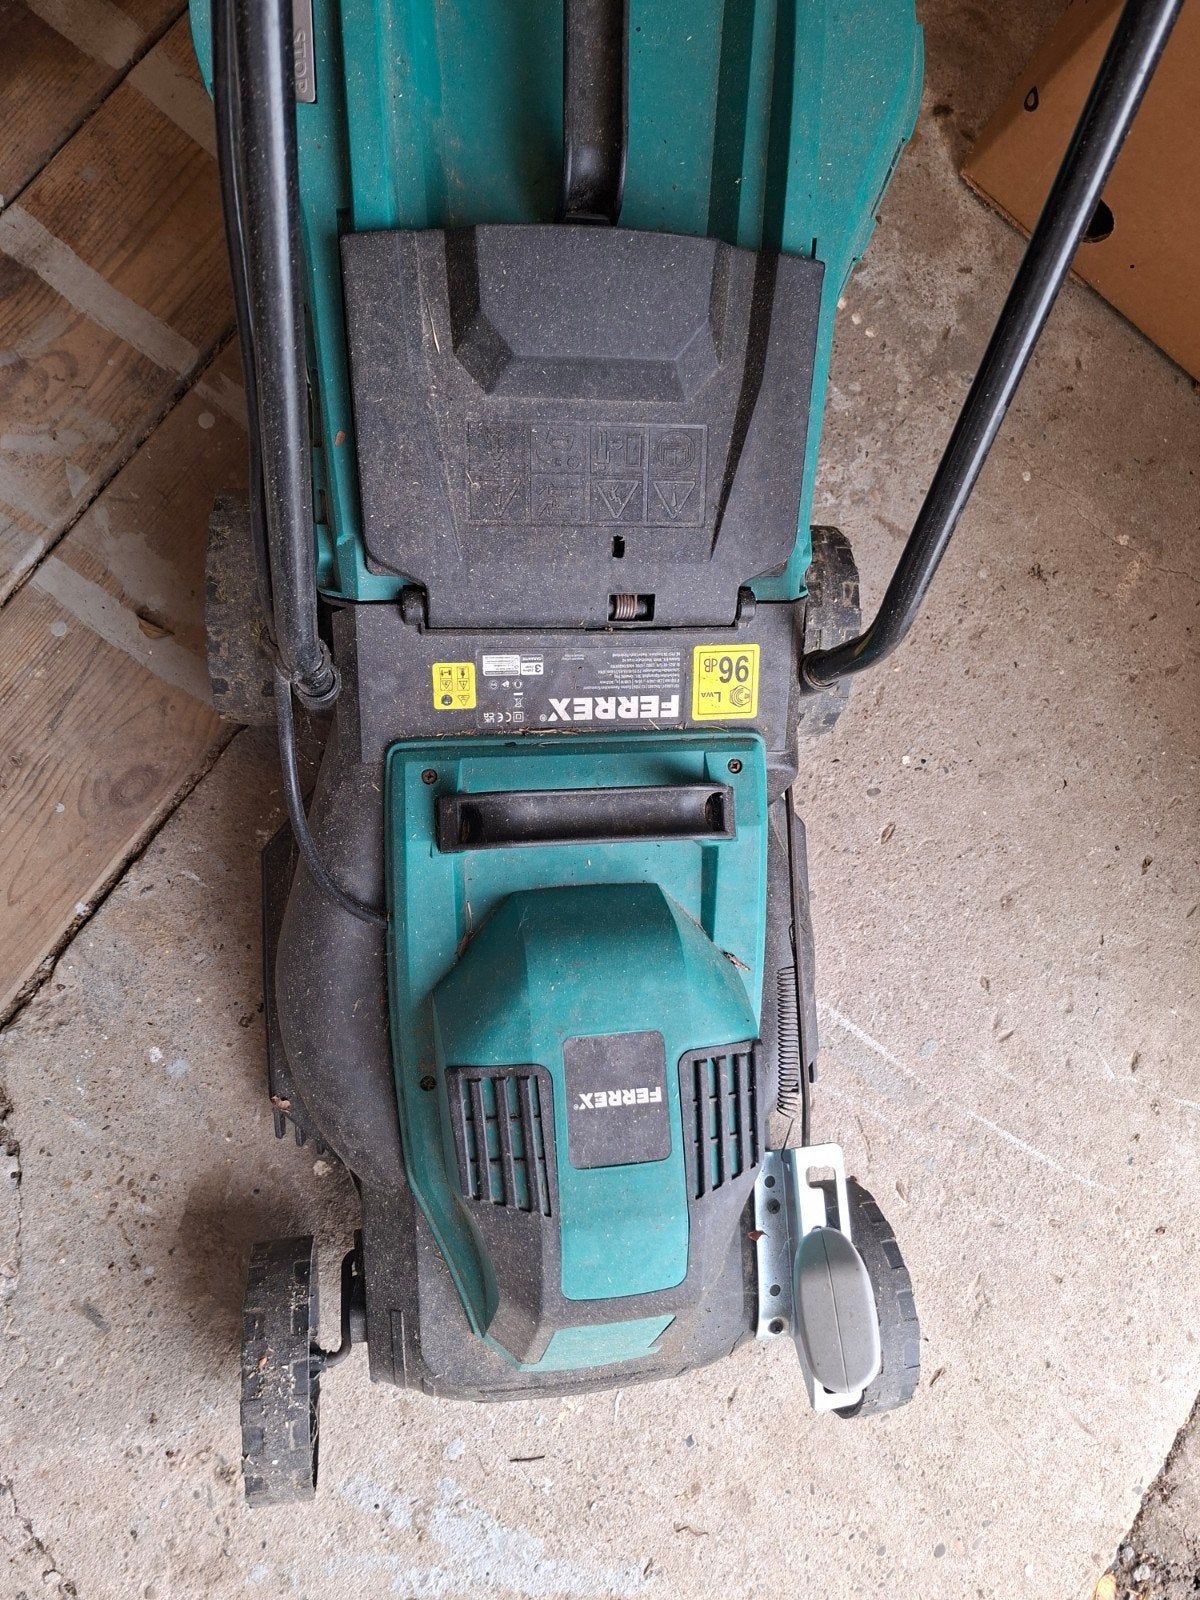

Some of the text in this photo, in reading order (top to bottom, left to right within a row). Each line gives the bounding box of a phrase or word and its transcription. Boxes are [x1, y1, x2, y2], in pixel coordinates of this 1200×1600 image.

[293, 28, 308, 94] STOP
[534, 664, 542, 673] 3
[703, 655, 749, 683] 96 dB
[547, 694, 680, 722] FERREX
[578, 1086, 662, 1110] FERREX
